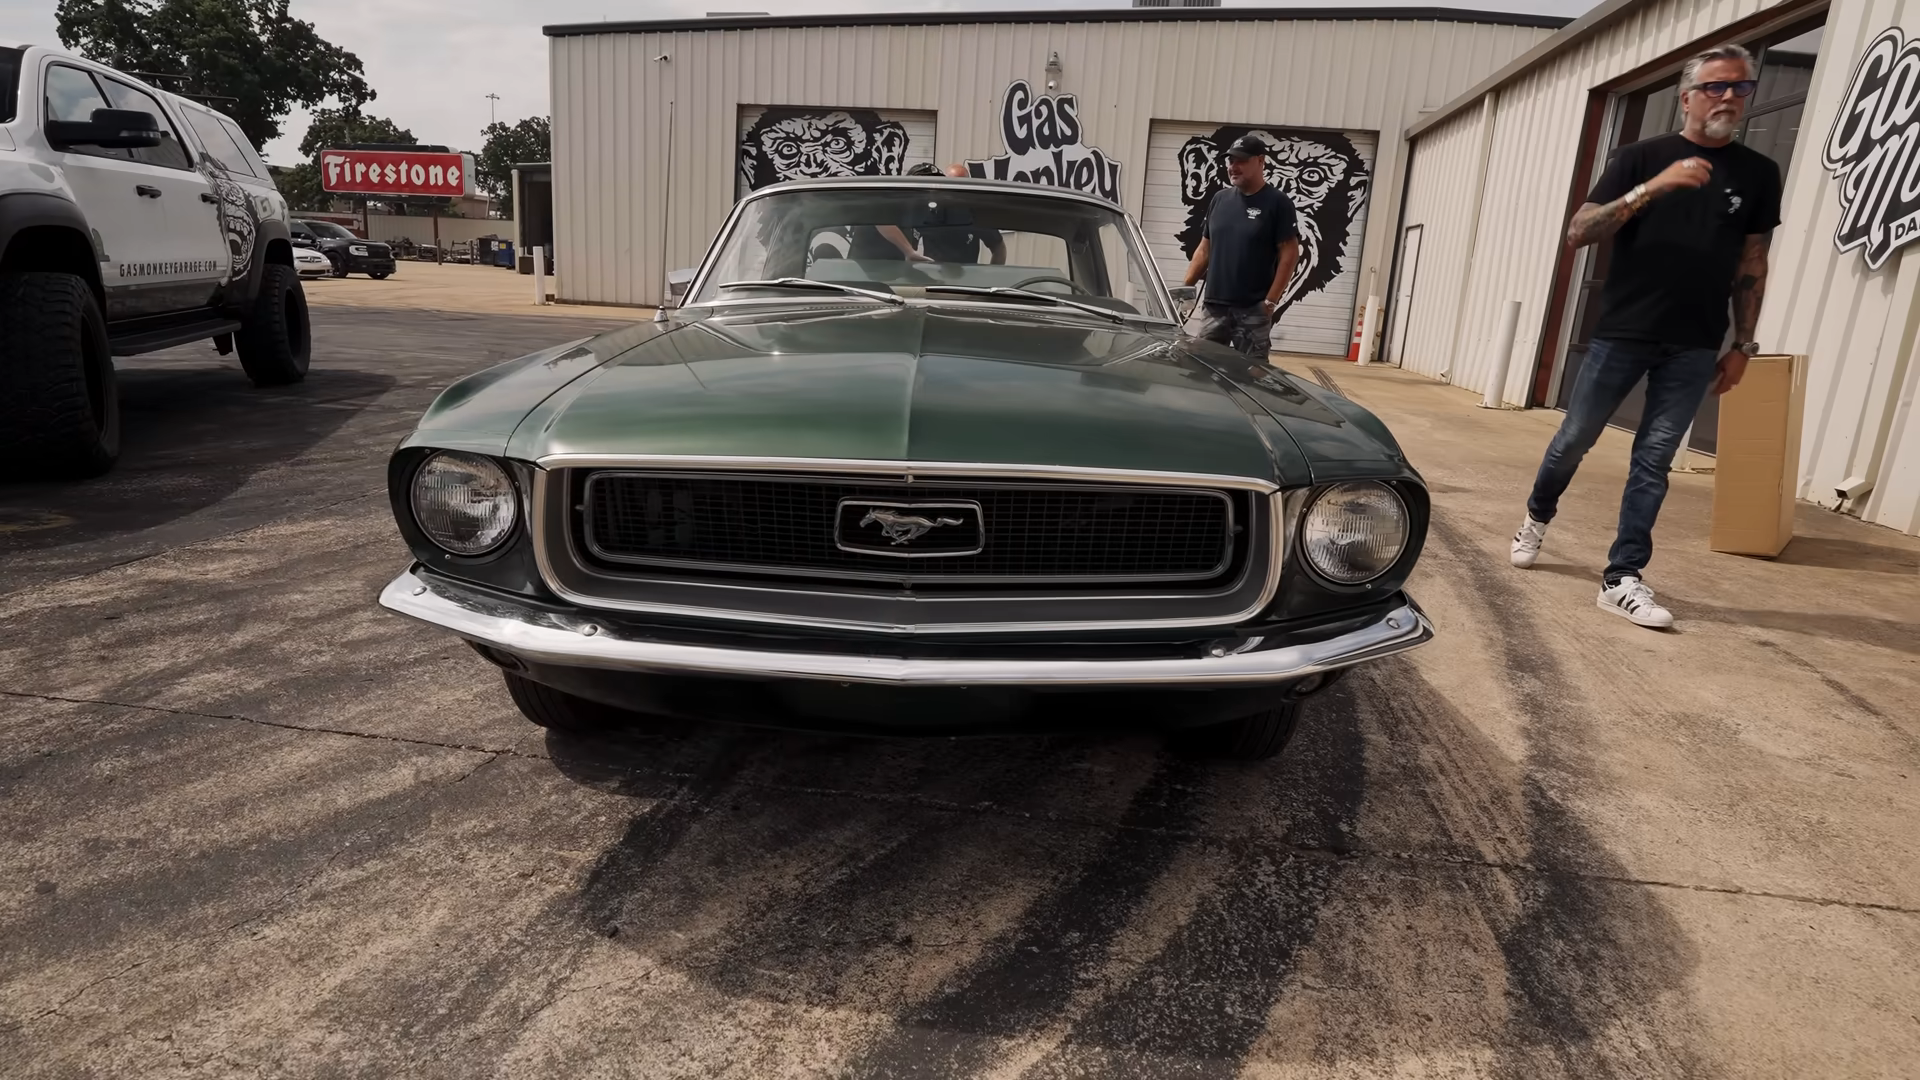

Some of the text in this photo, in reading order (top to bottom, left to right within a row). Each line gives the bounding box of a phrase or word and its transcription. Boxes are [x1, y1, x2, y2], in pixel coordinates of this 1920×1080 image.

[1003, 82, 1080, 156] Gas
[323, 154, 461, 187] Firestone
[1894, 216, 1920, 241] DA
[119, 260, 217, 278] GASMONKEYGARAGE.COM
